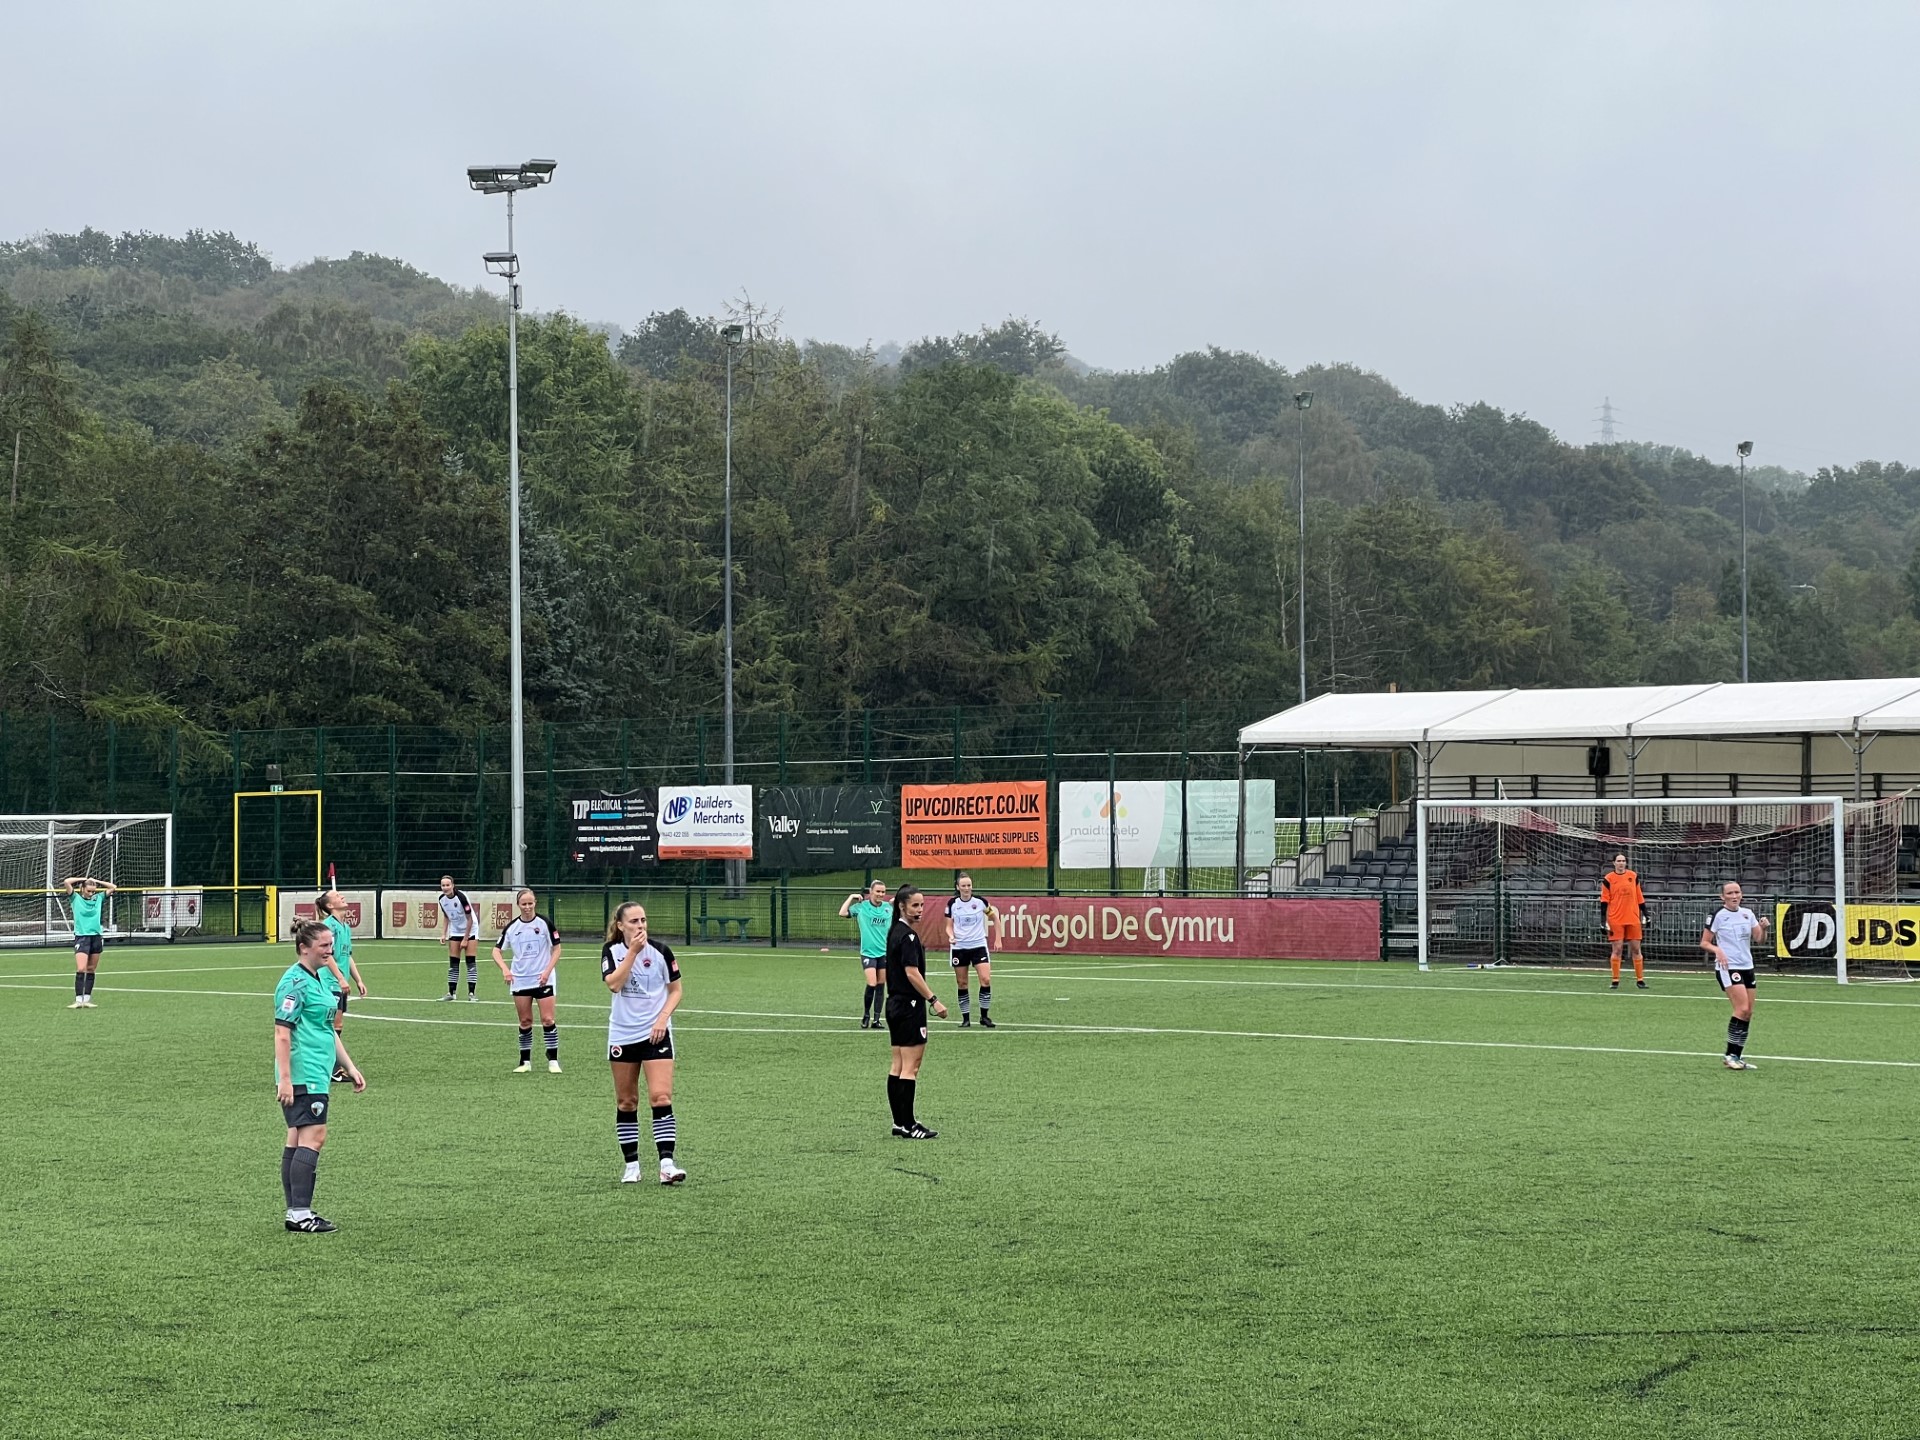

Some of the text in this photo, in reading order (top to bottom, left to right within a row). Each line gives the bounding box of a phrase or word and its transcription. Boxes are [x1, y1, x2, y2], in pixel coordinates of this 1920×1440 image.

[590, 799, 622, 811] ELECTRICAL
[668, 796, 688, 819] NB
[694, 795, 733, 809] Builders
[905, 794, 1040, 816] UPVCDIRECT.CO.UK
[693, 811, 745, 824] Merchants
[768, 816, 801, 838] Valley
[906, 832, 1039, 844] PROPERTY MAINTENANCE SUPPLIES
[1102, 907, 1138, 941] De
[1145, 907, 1234, 950] Cymru
[1790, 913, 1835, 950] JD
[1848, 919, 1920, 947] JDS
